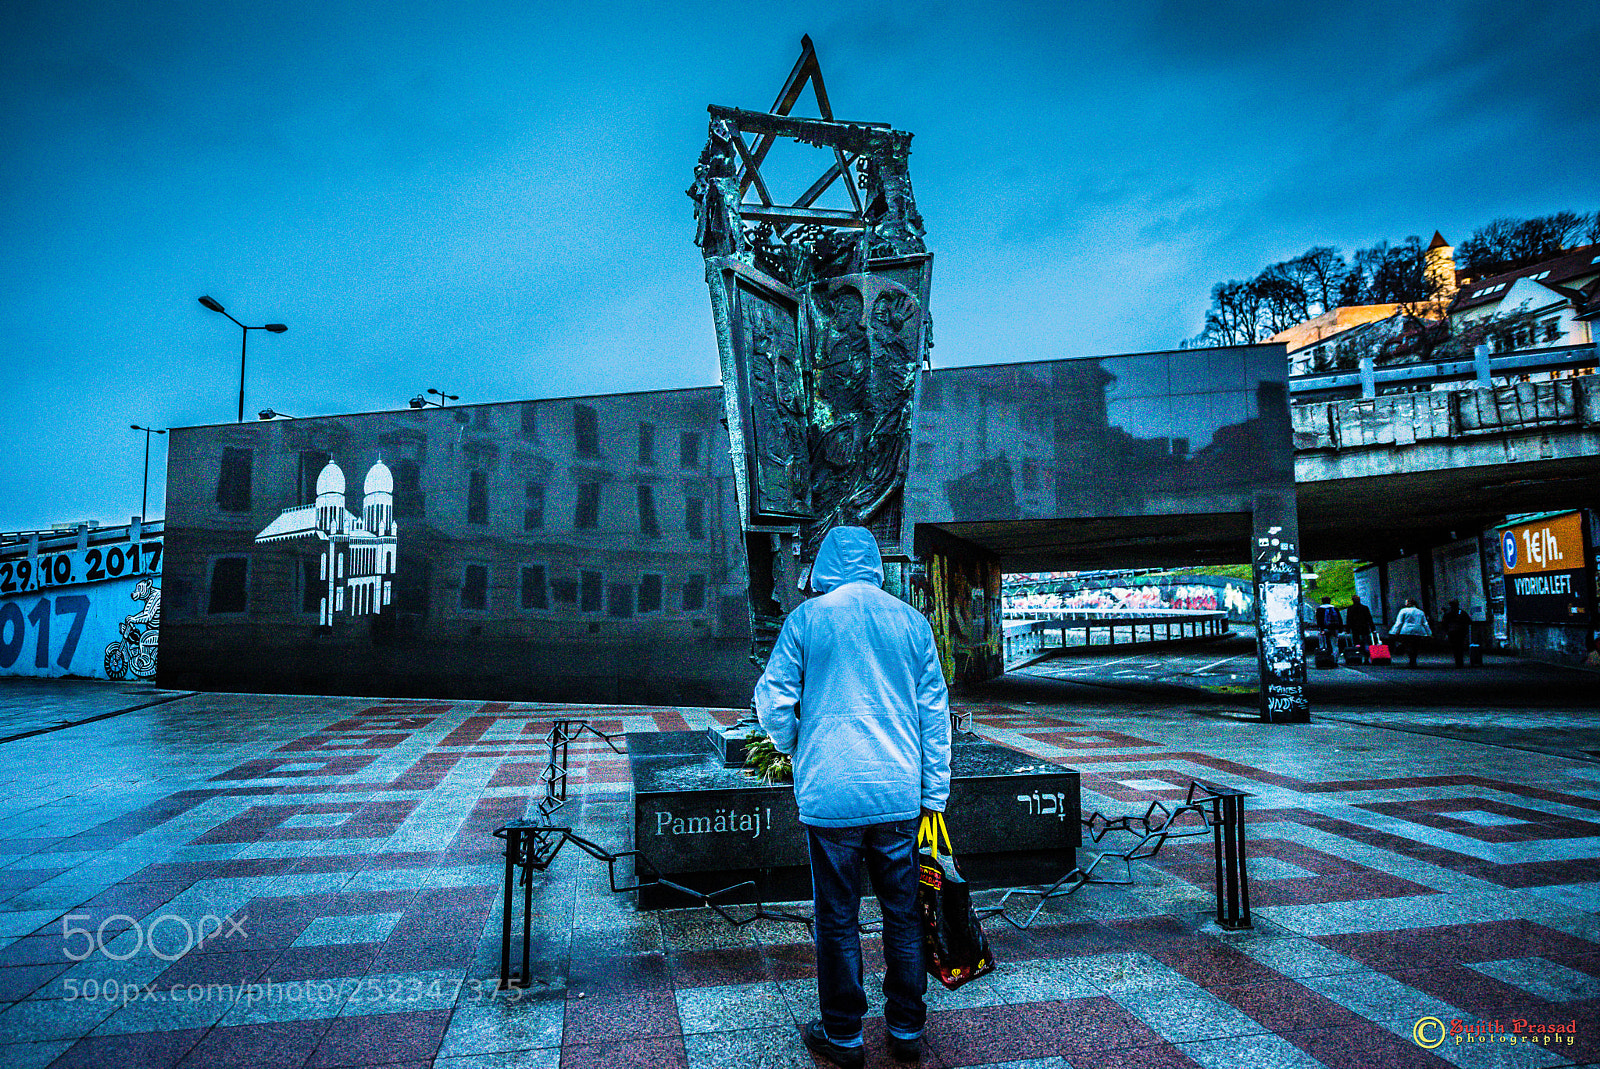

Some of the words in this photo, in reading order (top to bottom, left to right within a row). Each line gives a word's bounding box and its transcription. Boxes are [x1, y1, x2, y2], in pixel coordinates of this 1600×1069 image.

[85, 542, 163, 580] 2017
[1522, 527, 1563, 568] 1€/h.
[1514, 576, 1550, 596] VYDRICA
[1550, 574, 1571, 595] LEFT
[655, 806, 771, 839] Pamätaj!
